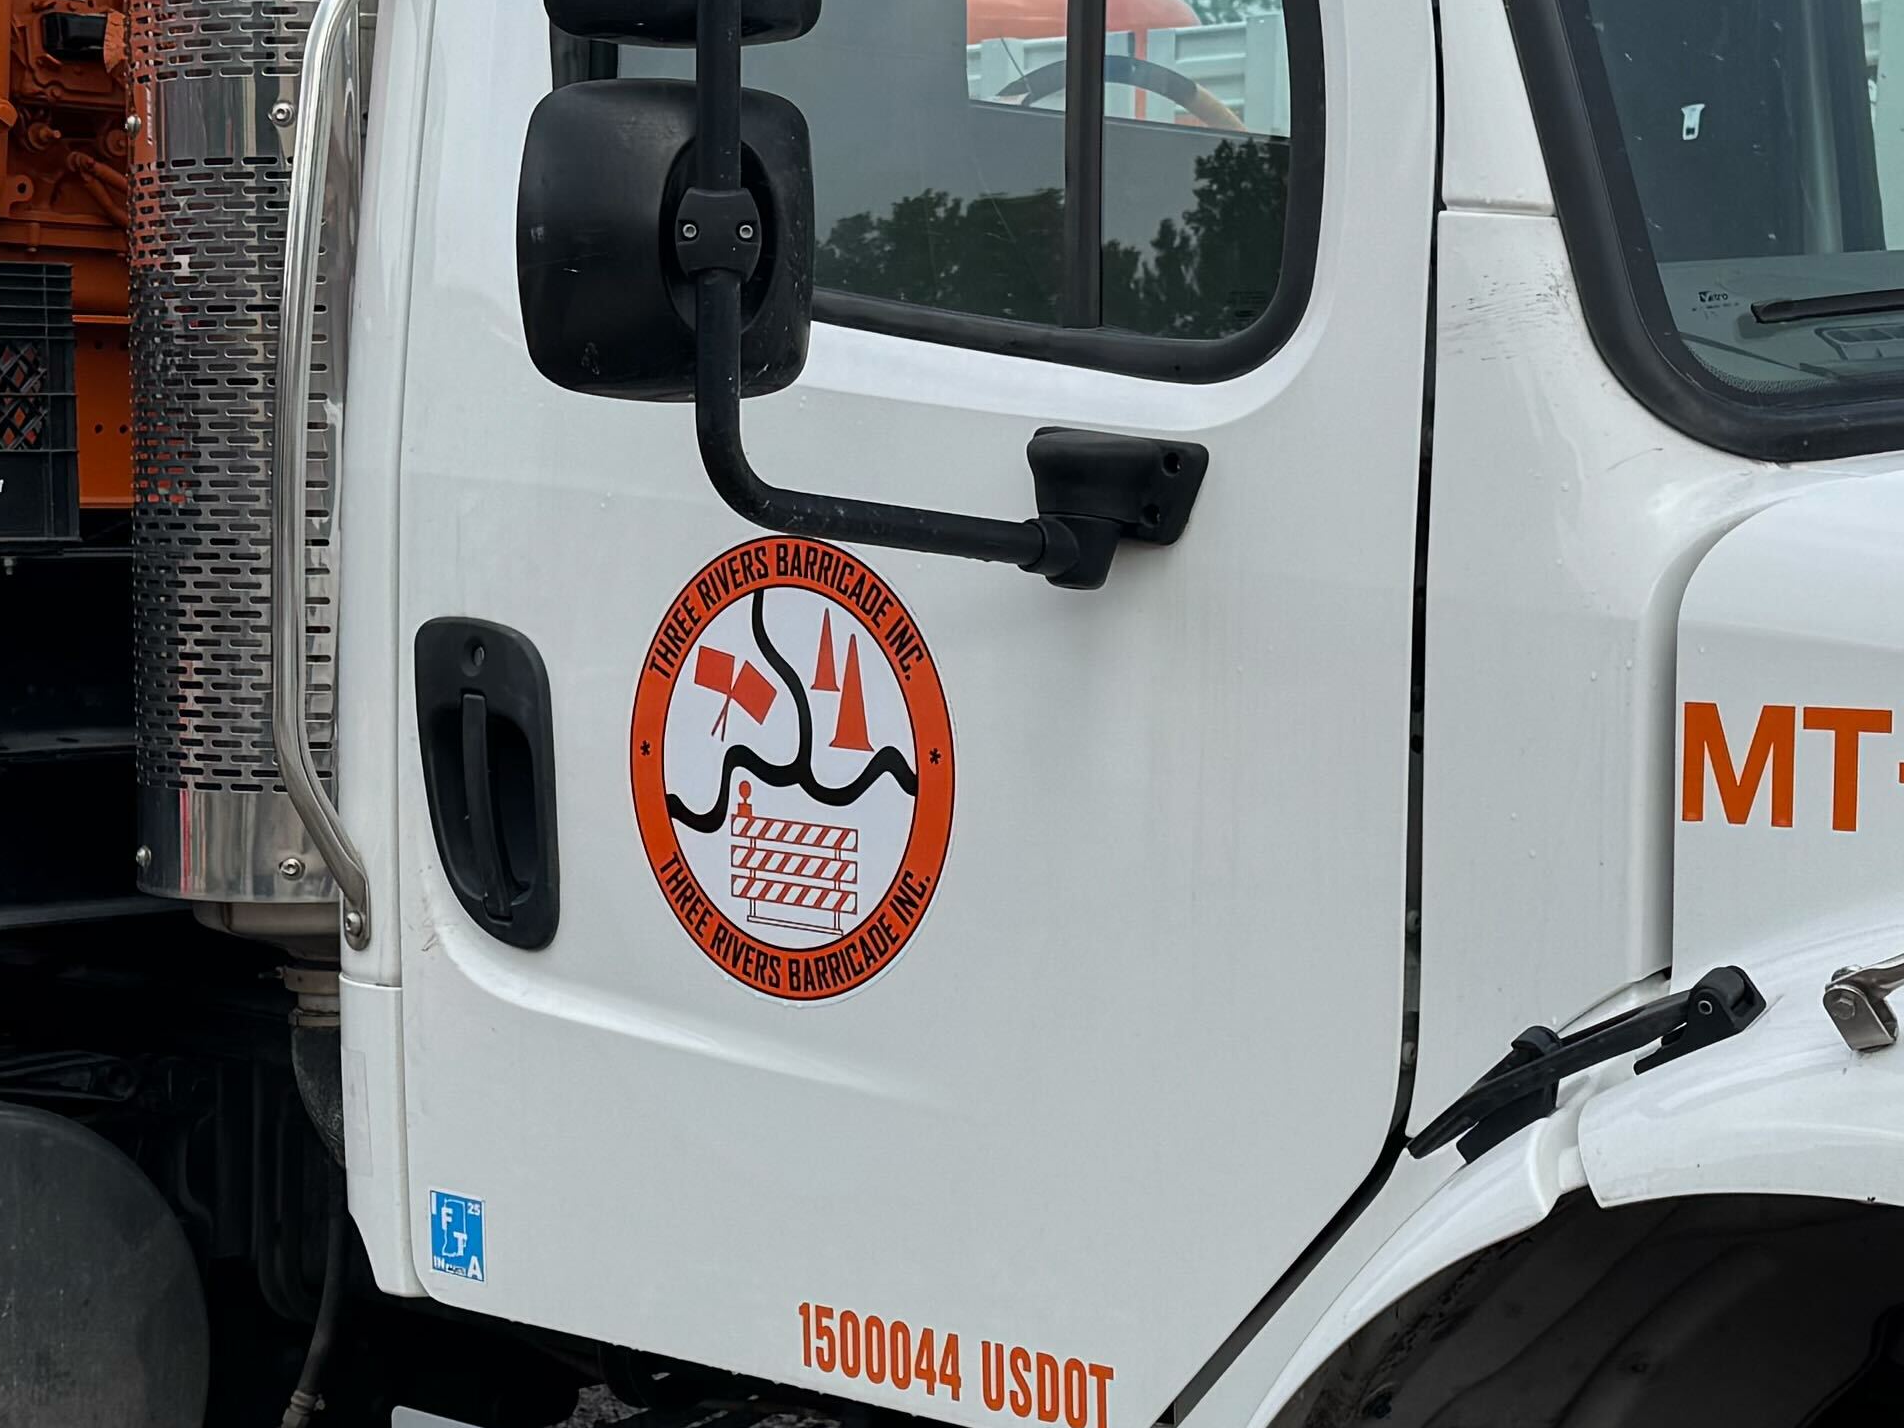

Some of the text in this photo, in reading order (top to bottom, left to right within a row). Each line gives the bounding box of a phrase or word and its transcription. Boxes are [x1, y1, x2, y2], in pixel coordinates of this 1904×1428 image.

[649, 543, 925, 681] THREE RIVERS BARRICADE INC.
[660, 852, 932, 992] THREE RIVERS BARRICADE INC.
[798, 1302, 962, 1402] 1500044
